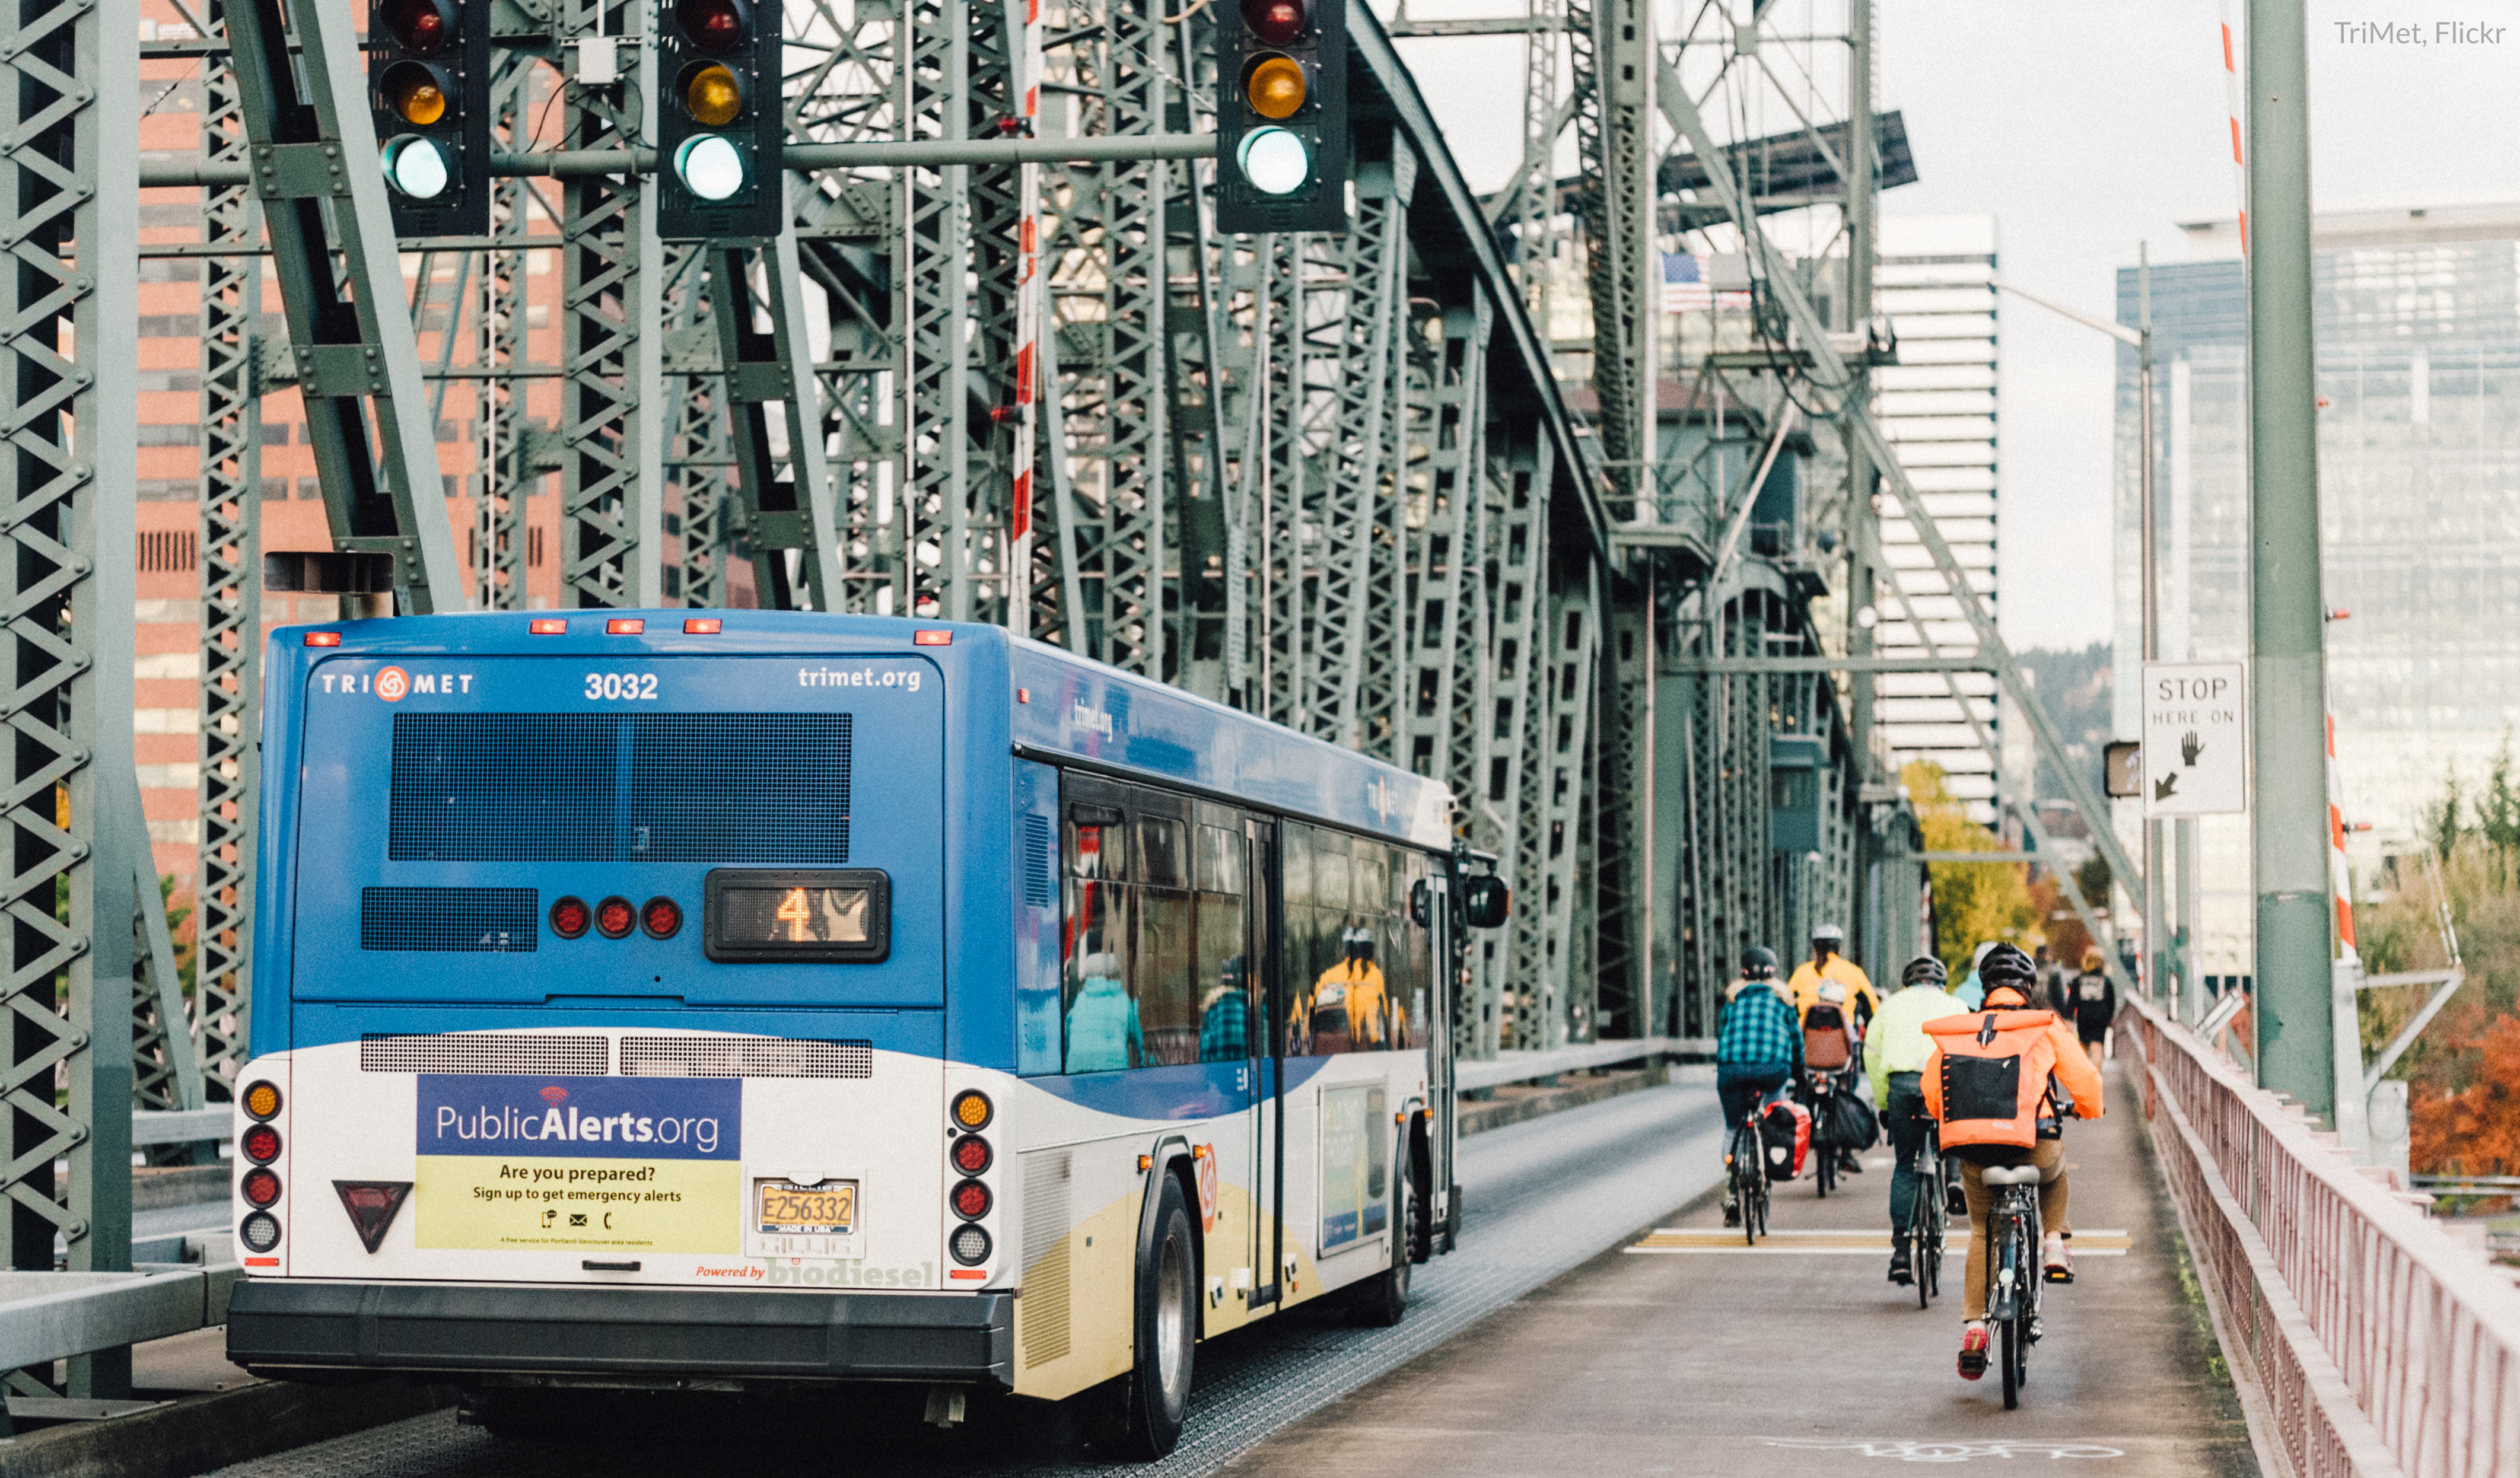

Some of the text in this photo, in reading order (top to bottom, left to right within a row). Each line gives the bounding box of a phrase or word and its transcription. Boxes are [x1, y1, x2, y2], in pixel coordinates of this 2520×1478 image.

[585, 673, 658, 700] 3032
[798, 667, 920, 692] trimet.org
[2159, 679, 2227, 700] STOP
[1075, 697, 1112, 743] trimet.org
[2153, 711, 2233, 725] HERE ON
[777, 887, 810, 942] 4
[438, 1106, 718, 1152] PublicAlerts.org
[499, 1165, 655, 1183] Are you prepared?
[473, 1187, 681, 1203] Sign up to get emergency alerts
[765, 1196, 850, 1221] E256332
[761, 1237, 850, 1254] GILLIG
[696, 1257, 933, 1287] Powered by biodiesel
